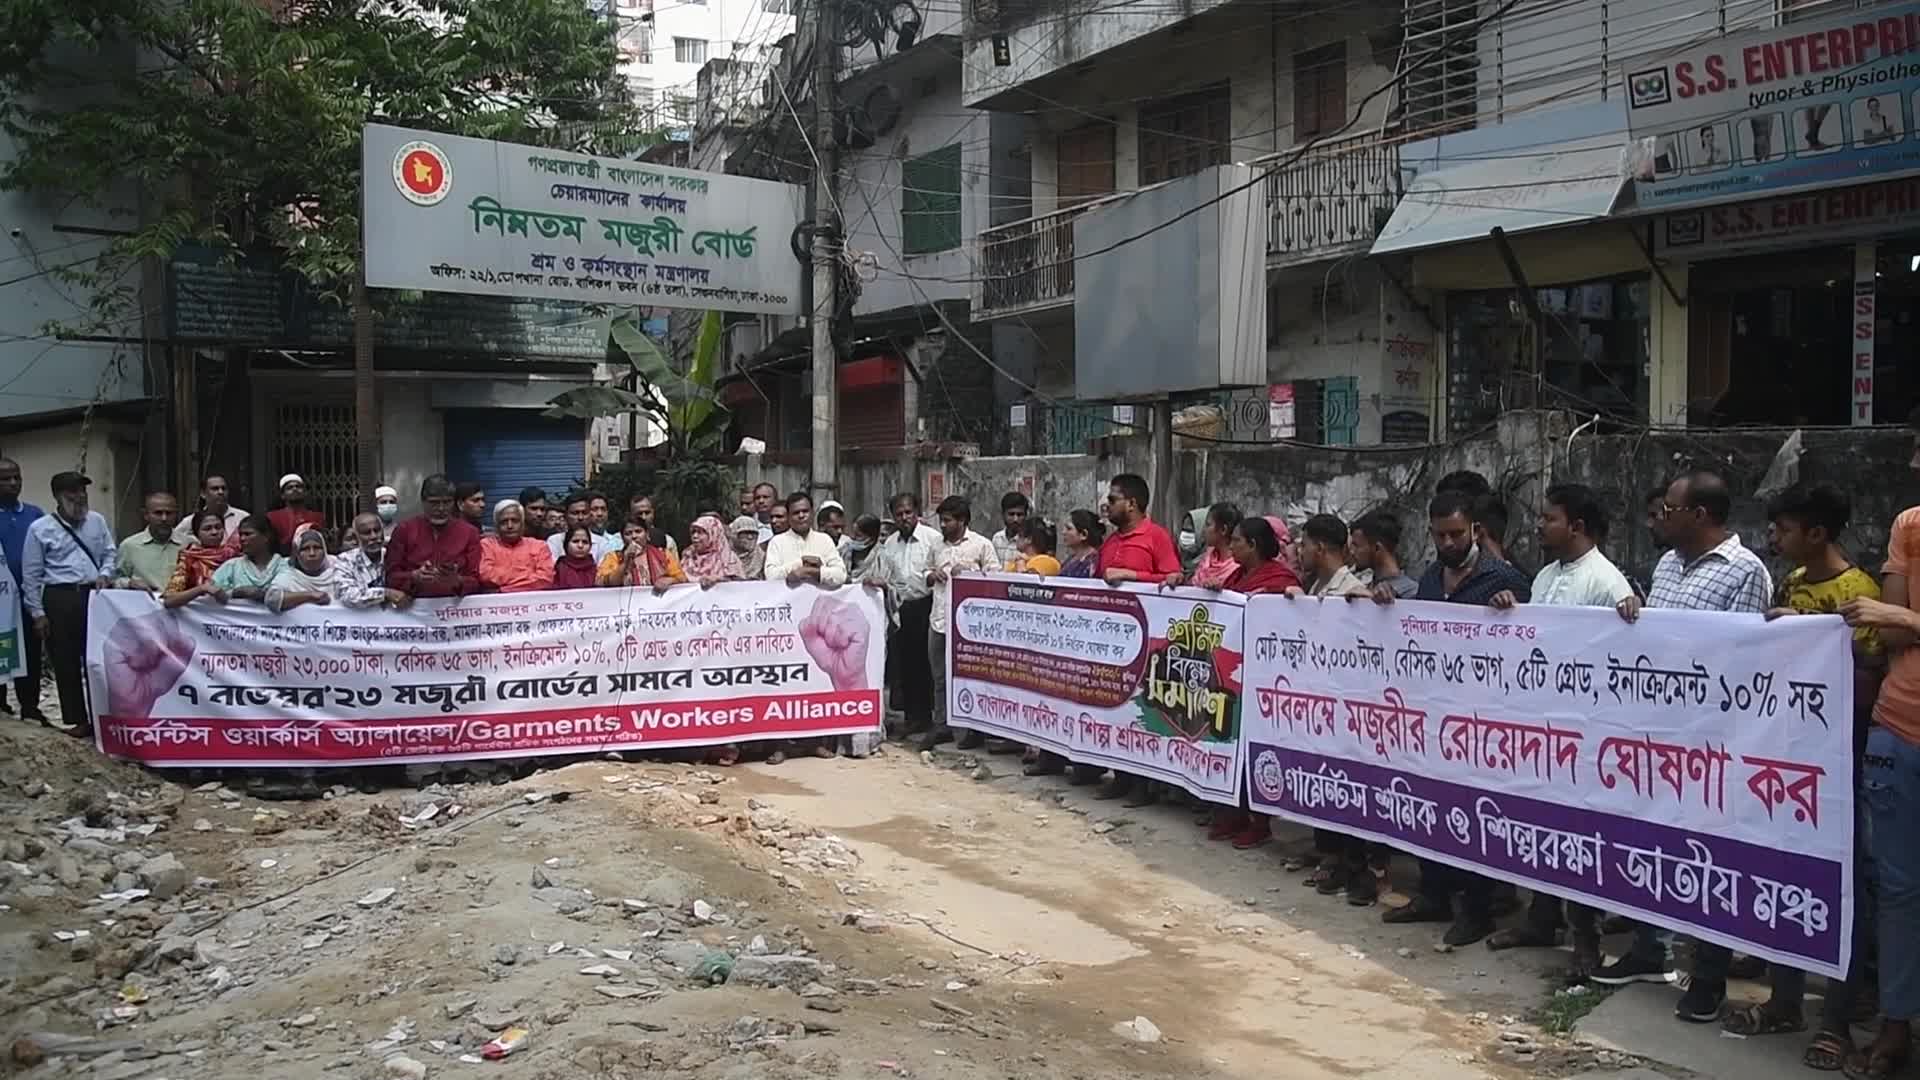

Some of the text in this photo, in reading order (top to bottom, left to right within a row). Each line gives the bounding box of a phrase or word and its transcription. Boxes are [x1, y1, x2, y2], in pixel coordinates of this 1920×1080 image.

[1675, 55, 1737, 98] S.S.
[1749, 88, 1796, 109] tynor
[1802, 80, 1815, 97] &
[550, 183, 687, 215] চেয়ারম্যানের কার্যালয়
[608, 168, 664, 188] বাংলাদেশ
[666, 175, 709, 194] সরকার
[469, 195, 759, 260] নিম্নতম মজুরী বোর্ড
[430, 263, 466, 281] অফিস:
[530, 252, 711, 286] শ্রম ও কর্মসংস্থান মন্ত্রণালয়
[286, 623, 320, 643] পোশাক
[454, 621, 513, 640] মামলা-হামলা
[755, 602, 776, 624] বিচার
[778, 602, 793, 624] চাই
[436, 602, 584, 621] দুনিয়ার মজদুর এক হও
[1168, 603, 1226, 657] শ্রমিক
[1400, 617, 1536, 641] দুনিয়ার মজদুর এক হও
[251, 646, 288, 679] মজুরী
[293, 653, 350, 680] ২৩,০০০
[352, 648, 389, 679] টাকা,
[395, 645, 437, 673] বেসিক
[442, 652, 462, 671] ৬৫
[467, 649, 498, 673] ভাগ,
[503, 641, 568, 668] ইনক্রিমেন্ট
[574, 639, 611, 668] ১০%,
[616, 635, 638, 662] ৫টি
[643, 640, 668, 661] গ্রেড
[674, 642, 683, 657] ও
[688, 630, 730, 658] রেশনিং
[734, 635, 753, 656] এর
[755, 627, 796, 656] দাবিতে
[178, 684, 198, 705] ৭
[391, 674, 487, 712] মজুরী
[497, 669, 598, 701] বোর্ডের
[606, 668, 693, 695] সামনে
[703, 662, 809, 688] অবস্থান
[1256, 629, 1829, 729] মোট মজুরী ২৩,০০০ টাকা, বেসিক ৬৫ ভাগ, ৫টি গ্রেড, ইনক্রিমেন্ট ১০% সহ
[109, 718, 212, 747] গার্মেন্টস
[222, 721, 323, 748] ওয়ার্কার্স
[632, 704, 754, 730] Workers
[763, 694, 874, 722] Alliance
[976, 693, 1020, 723] বাংলাদেশ
[1079, 711, 1112, 748] শিল্প
[1116, 720, 1161, 757] শ্রমিক
[1256, 675, 1827, 830] অবিলম্বে মজুরীর রোয়েদাদ ঘোষণা কর
[1285, 762, 1368, 817] গার্মেন্টস
[1372, 777, 1439, 836] শ্রমিক
[1446, 807, 1471, 845] ও
[1475, 797, 1607, 886] শিল্পরক্ষা
[1612, 838, 1742, 918] জাতীয়
[1751, 873, 1829, 937] মঞ্চ
